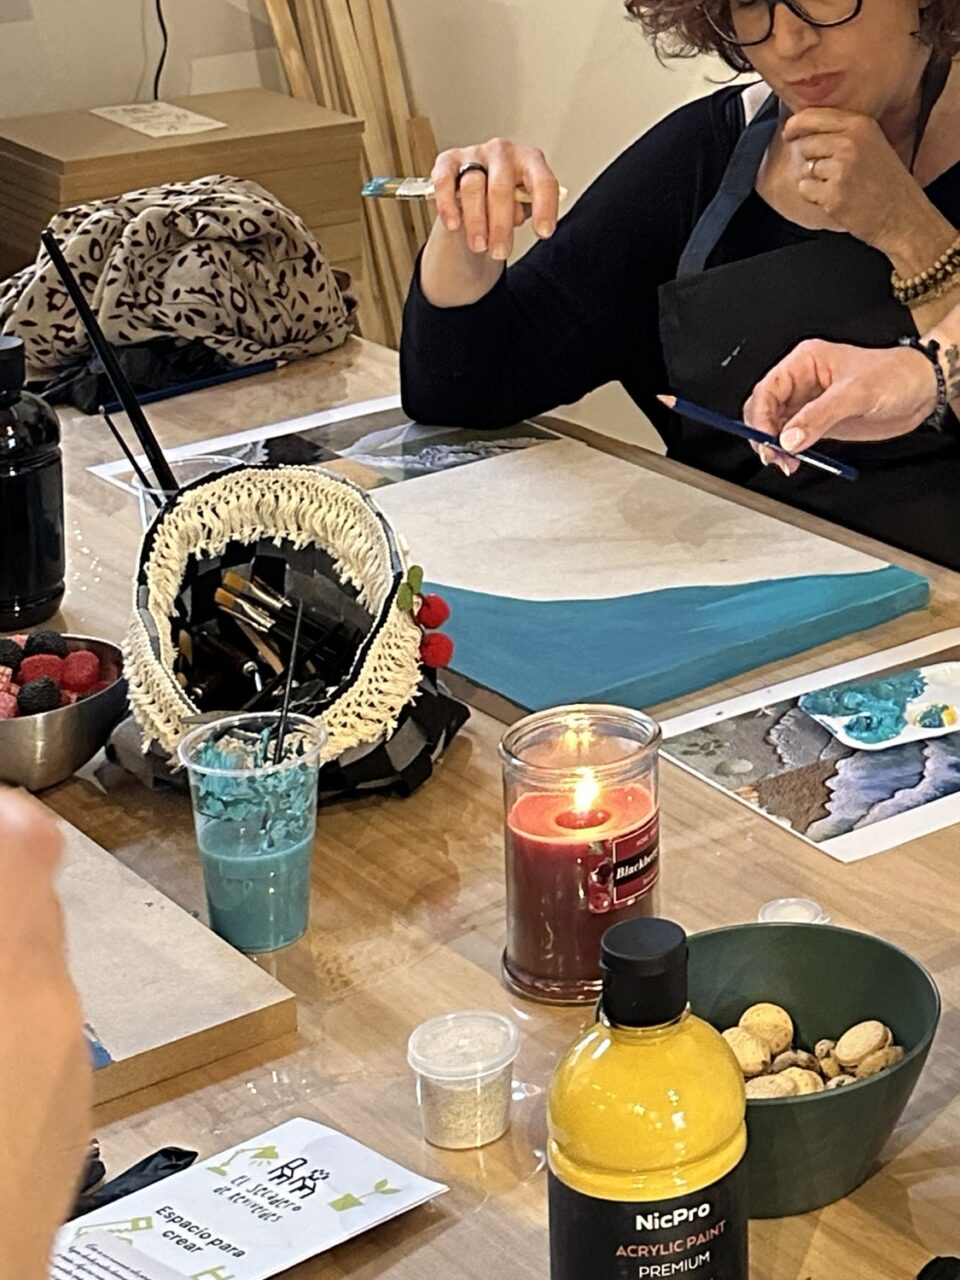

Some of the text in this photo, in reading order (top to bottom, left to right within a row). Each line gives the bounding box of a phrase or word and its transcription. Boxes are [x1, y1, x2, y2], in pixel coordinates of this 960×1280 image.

[635, 1203, 711, 1231] NicPro
[155, 1205, 246, 1259] Espacio para
[161, 1227, 204, 1255] crear
[615, 1219, 727, 1258] ACRYLIC PAINT
[639, 1250, 711, 1278] PREMIUM
